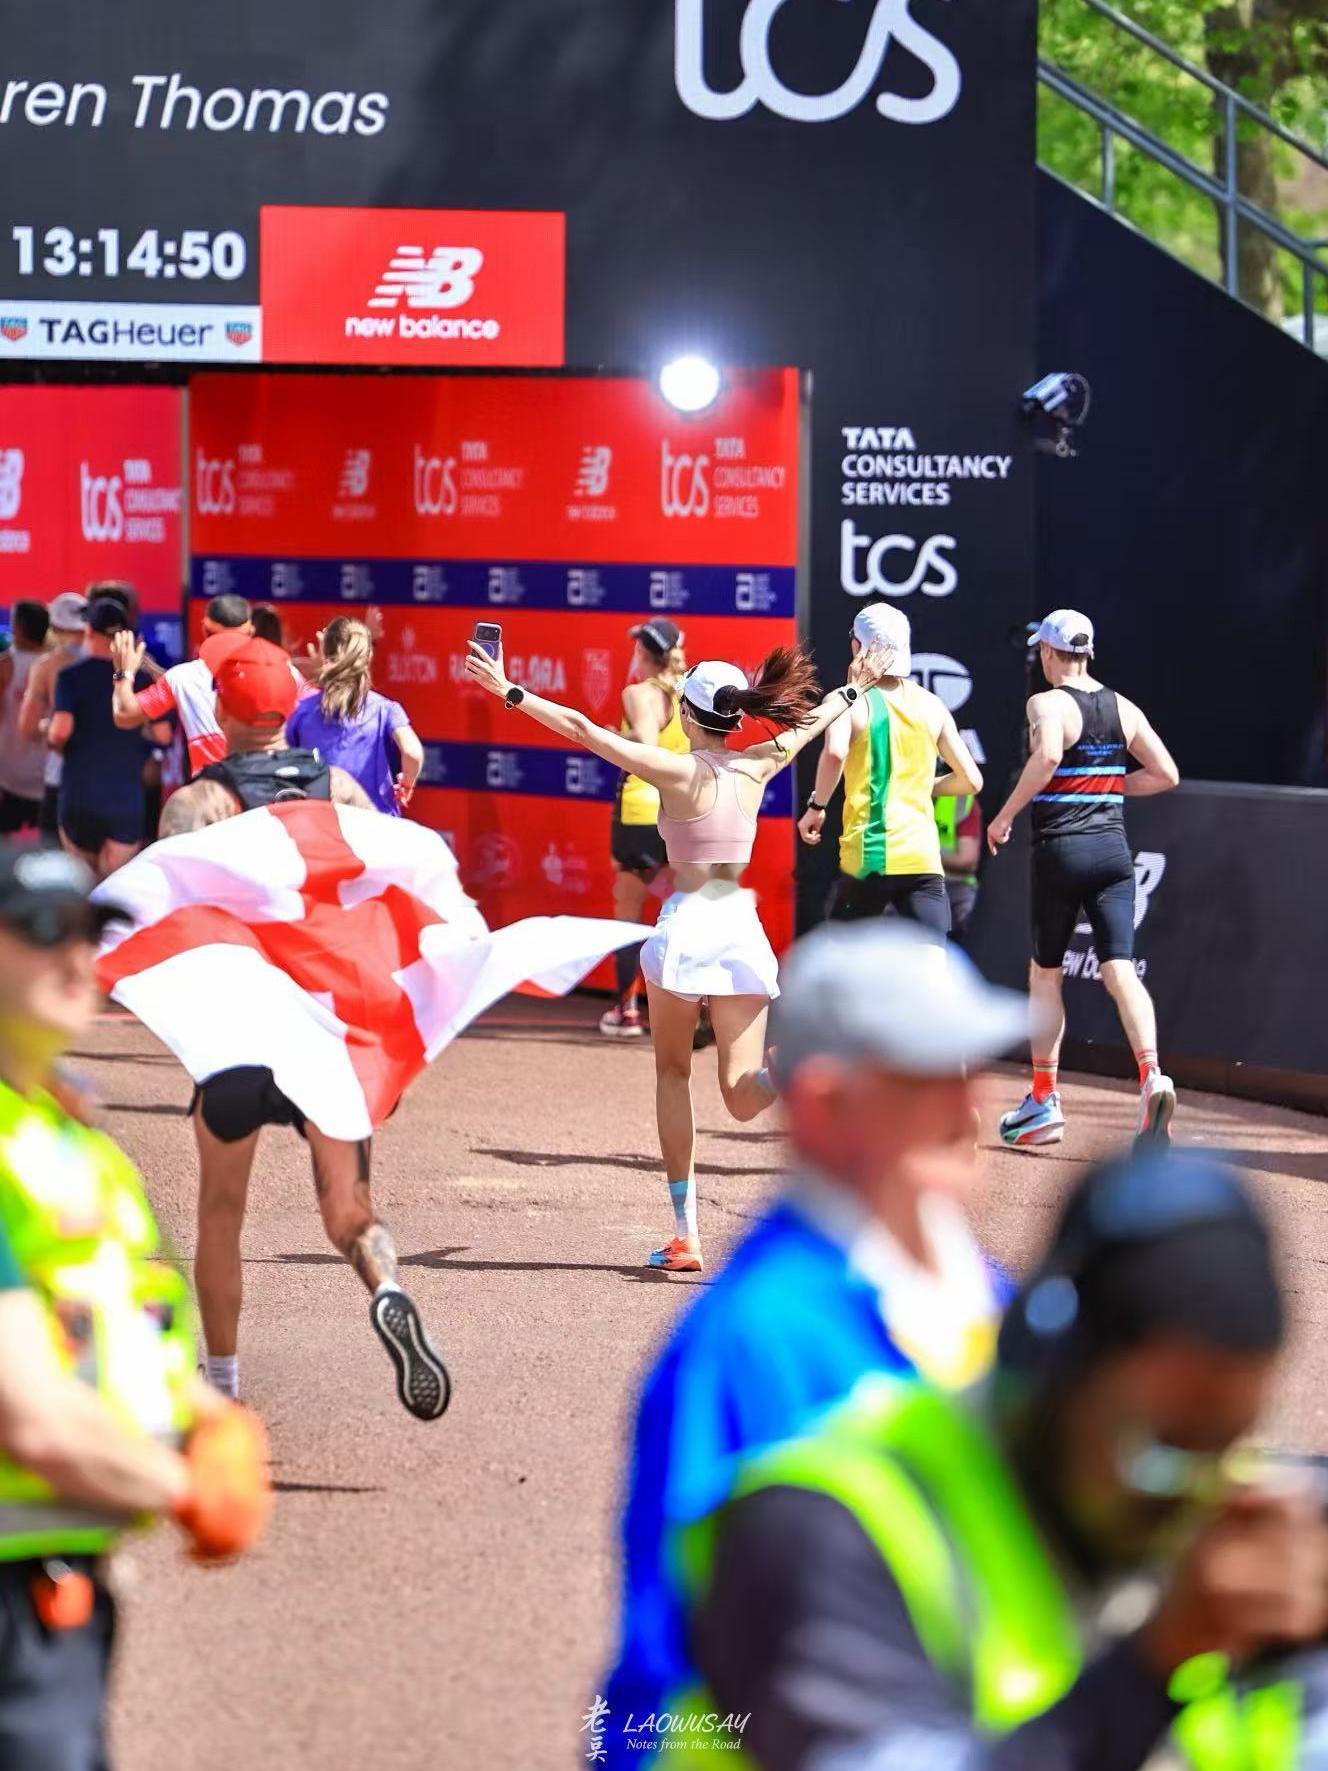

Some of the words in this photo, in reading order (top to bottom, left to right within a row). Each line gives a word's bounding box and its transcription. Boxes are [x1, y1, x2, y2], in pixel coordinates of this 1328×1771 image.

[132, 73, 389, 136] Thomas
[12, 226, 247, 280] 13:14:50
[345, 317, 395, 338] new
[399, 314, 500, 340] balance
[841, 427, 916, 450] TATA
[841, 454, 1012, 478] CONSULTANCY
[80, 460, 123, 542] tcs
[197, 446, 235, 514] tcs
[414, 443, 458, 516] tcs
[661, 438, 710, 517] tcs
[841, 482, 951, 506] SERVICES
[841, 518, 958, 597] tcs
[1062, 949, 1086, 976] ew
